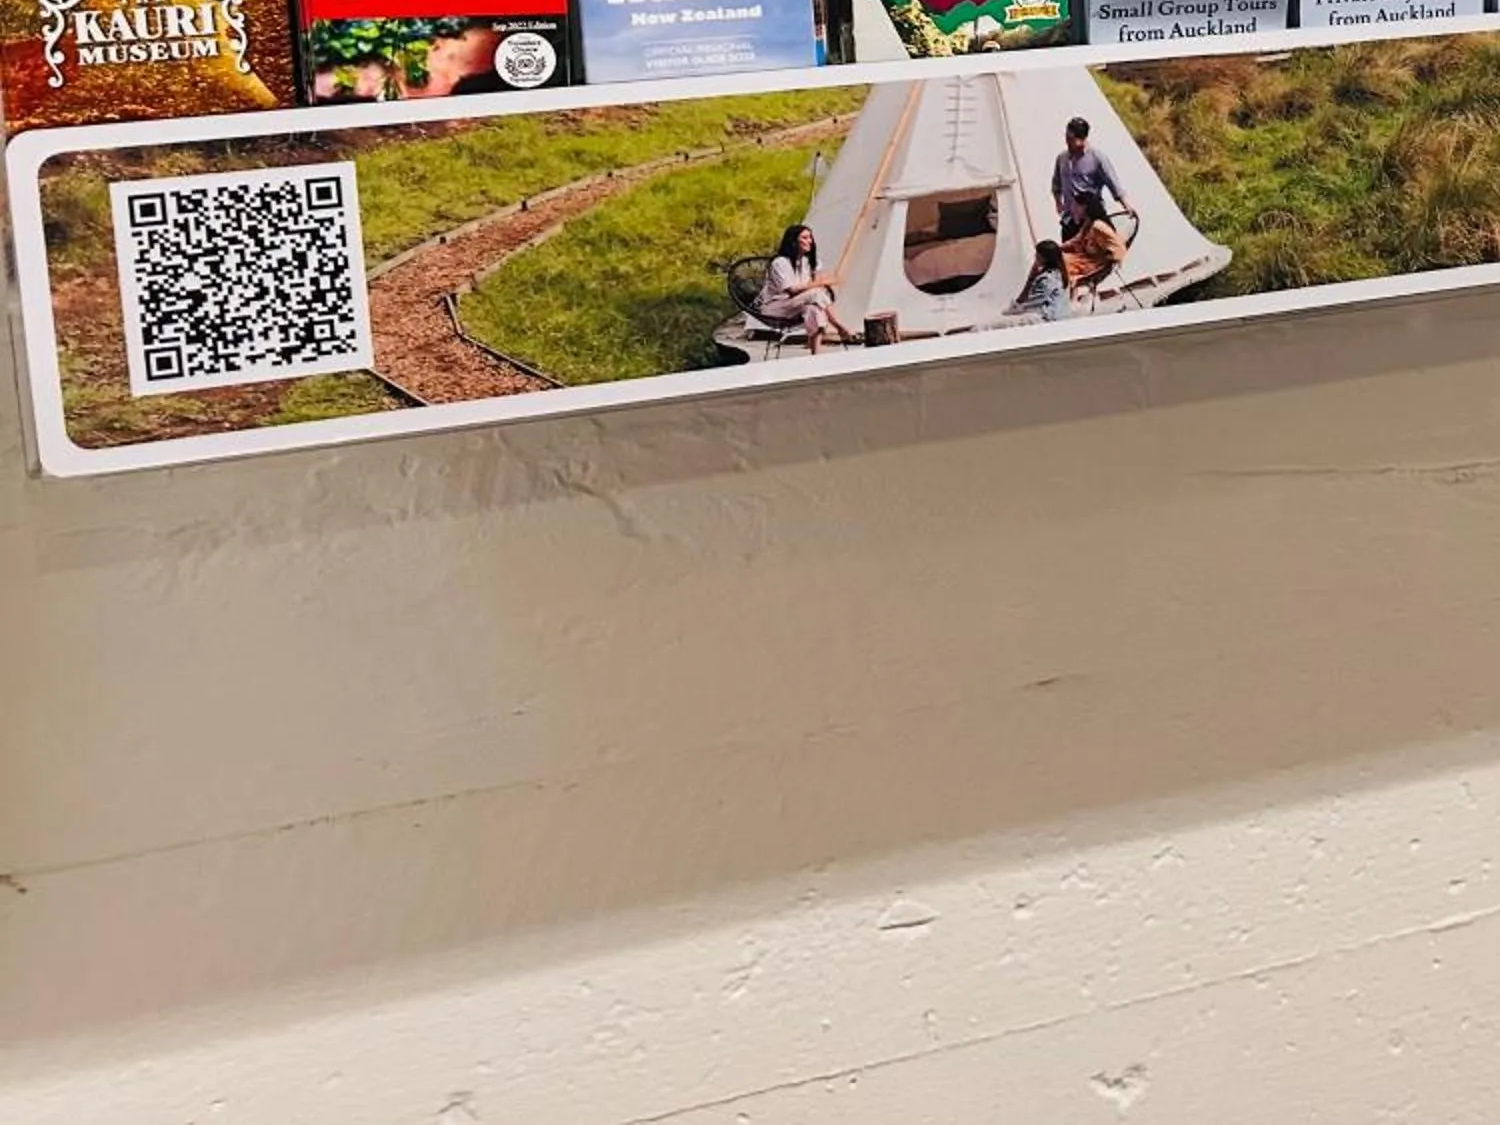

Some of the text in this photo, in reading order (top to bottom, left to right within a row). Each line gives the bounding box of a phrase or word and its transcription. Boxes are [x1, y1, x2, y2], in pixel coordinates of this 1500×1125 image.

[631, 5, 762, 26] New Zealand
[1099, 4, 1152, 20] Small
[1158, 1, 1218, 23] Group
[1329, 3, 1455, 26] from Auckland
[75, 4, 217, 45] KAURI
[1119, 17, 1257, 43] from Auckland
[78, 39, 219, 66] MUSEUM
